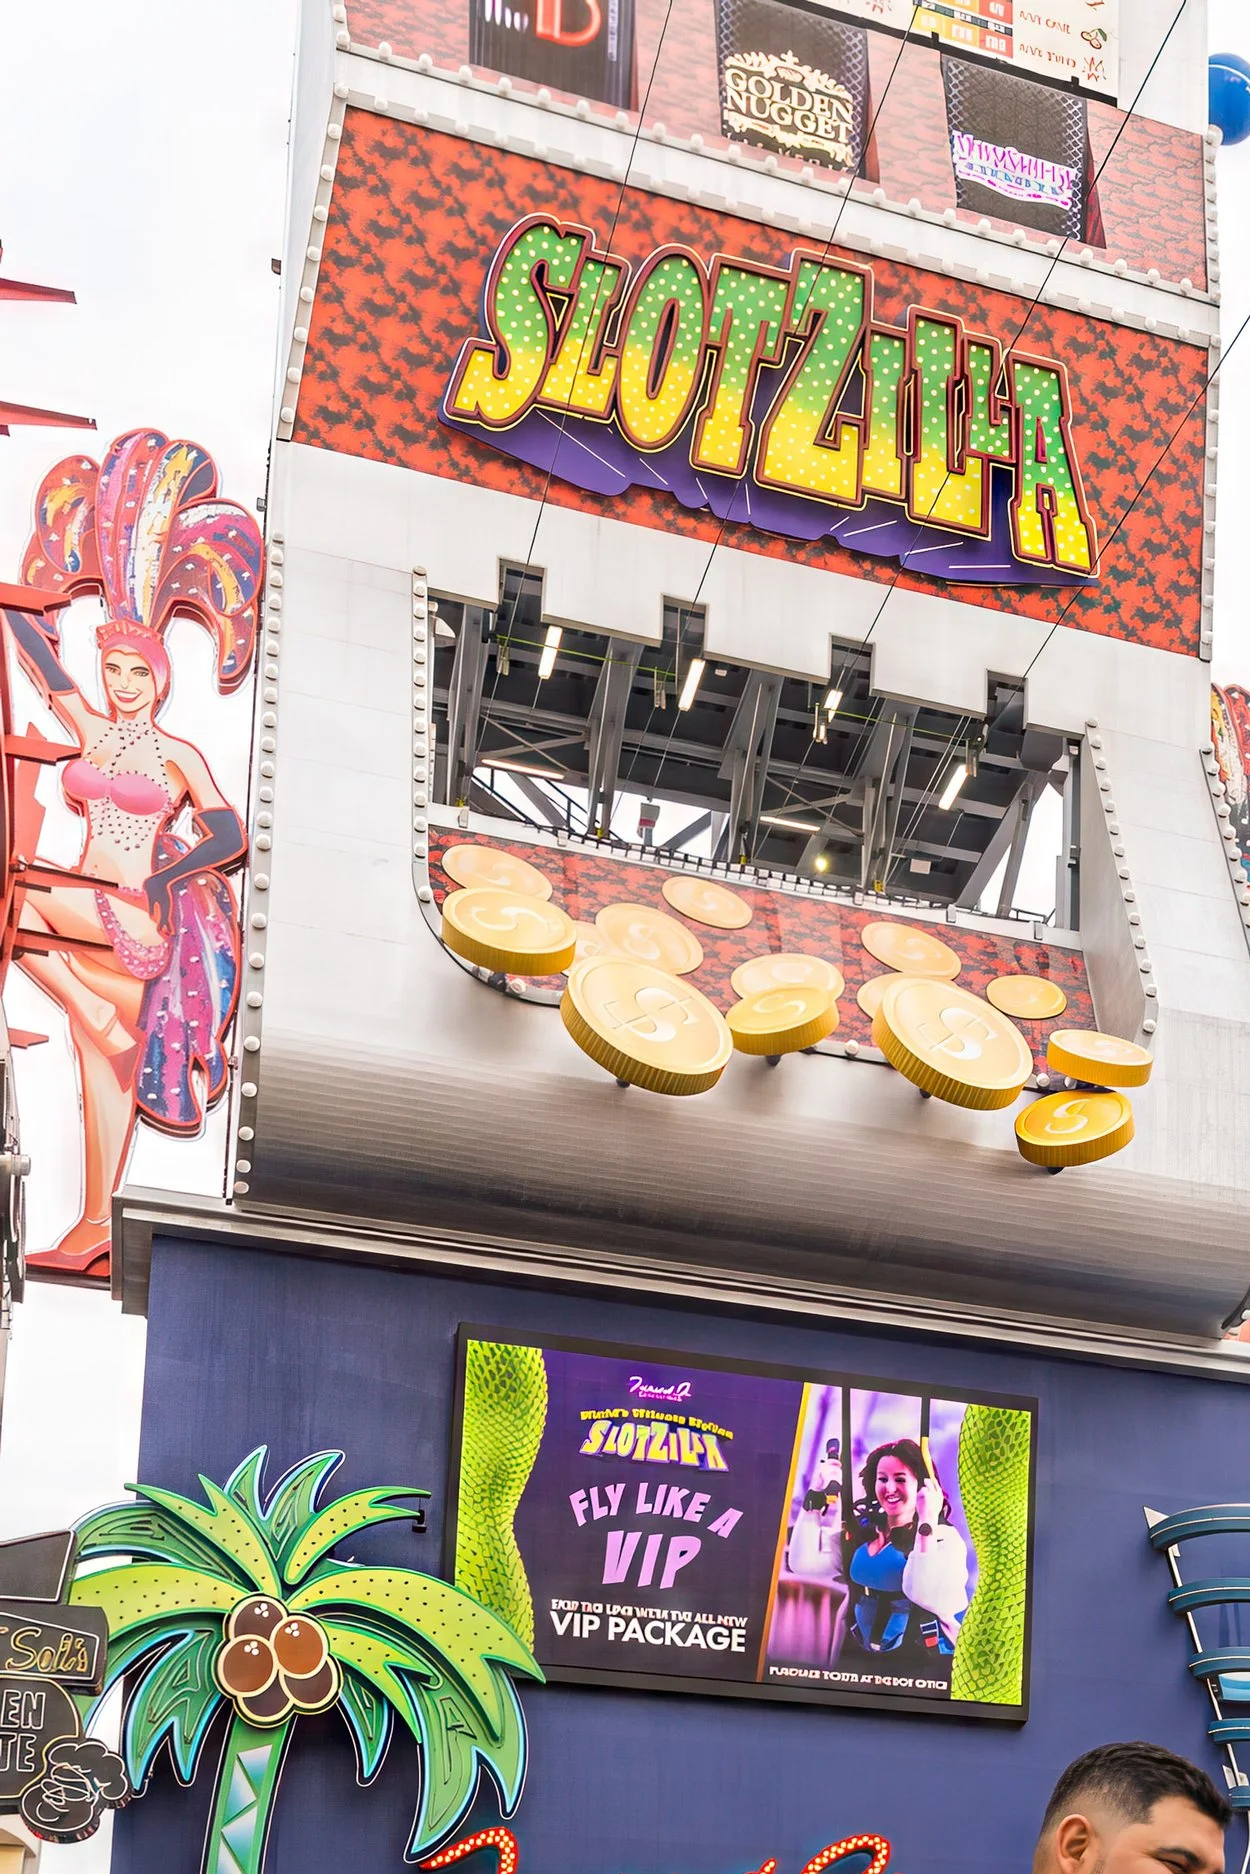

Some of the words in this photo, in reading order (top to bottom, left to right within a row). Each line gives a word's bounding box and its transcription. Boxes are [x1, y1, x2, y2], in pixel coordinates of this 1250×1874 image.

[725, 67, 854, 125] GOLDEN
[726, 84, 855, 144] NUGGET
[445, 212, 1099, 578] SLOTZILLA
[568, 1483, 627, 1527] FLY
[635, 1482, 712, 1523] LIKE
[706, 1507, 744, 1539] A
[602, 1530, 702, 1589] VIP
[549, 1611, 601, 1639] VIP
[607, 1617, 747, 1653] PACKAGE
[0, 1689, 46, 1730] EN
[0, 1731, 37, 1772] TE
